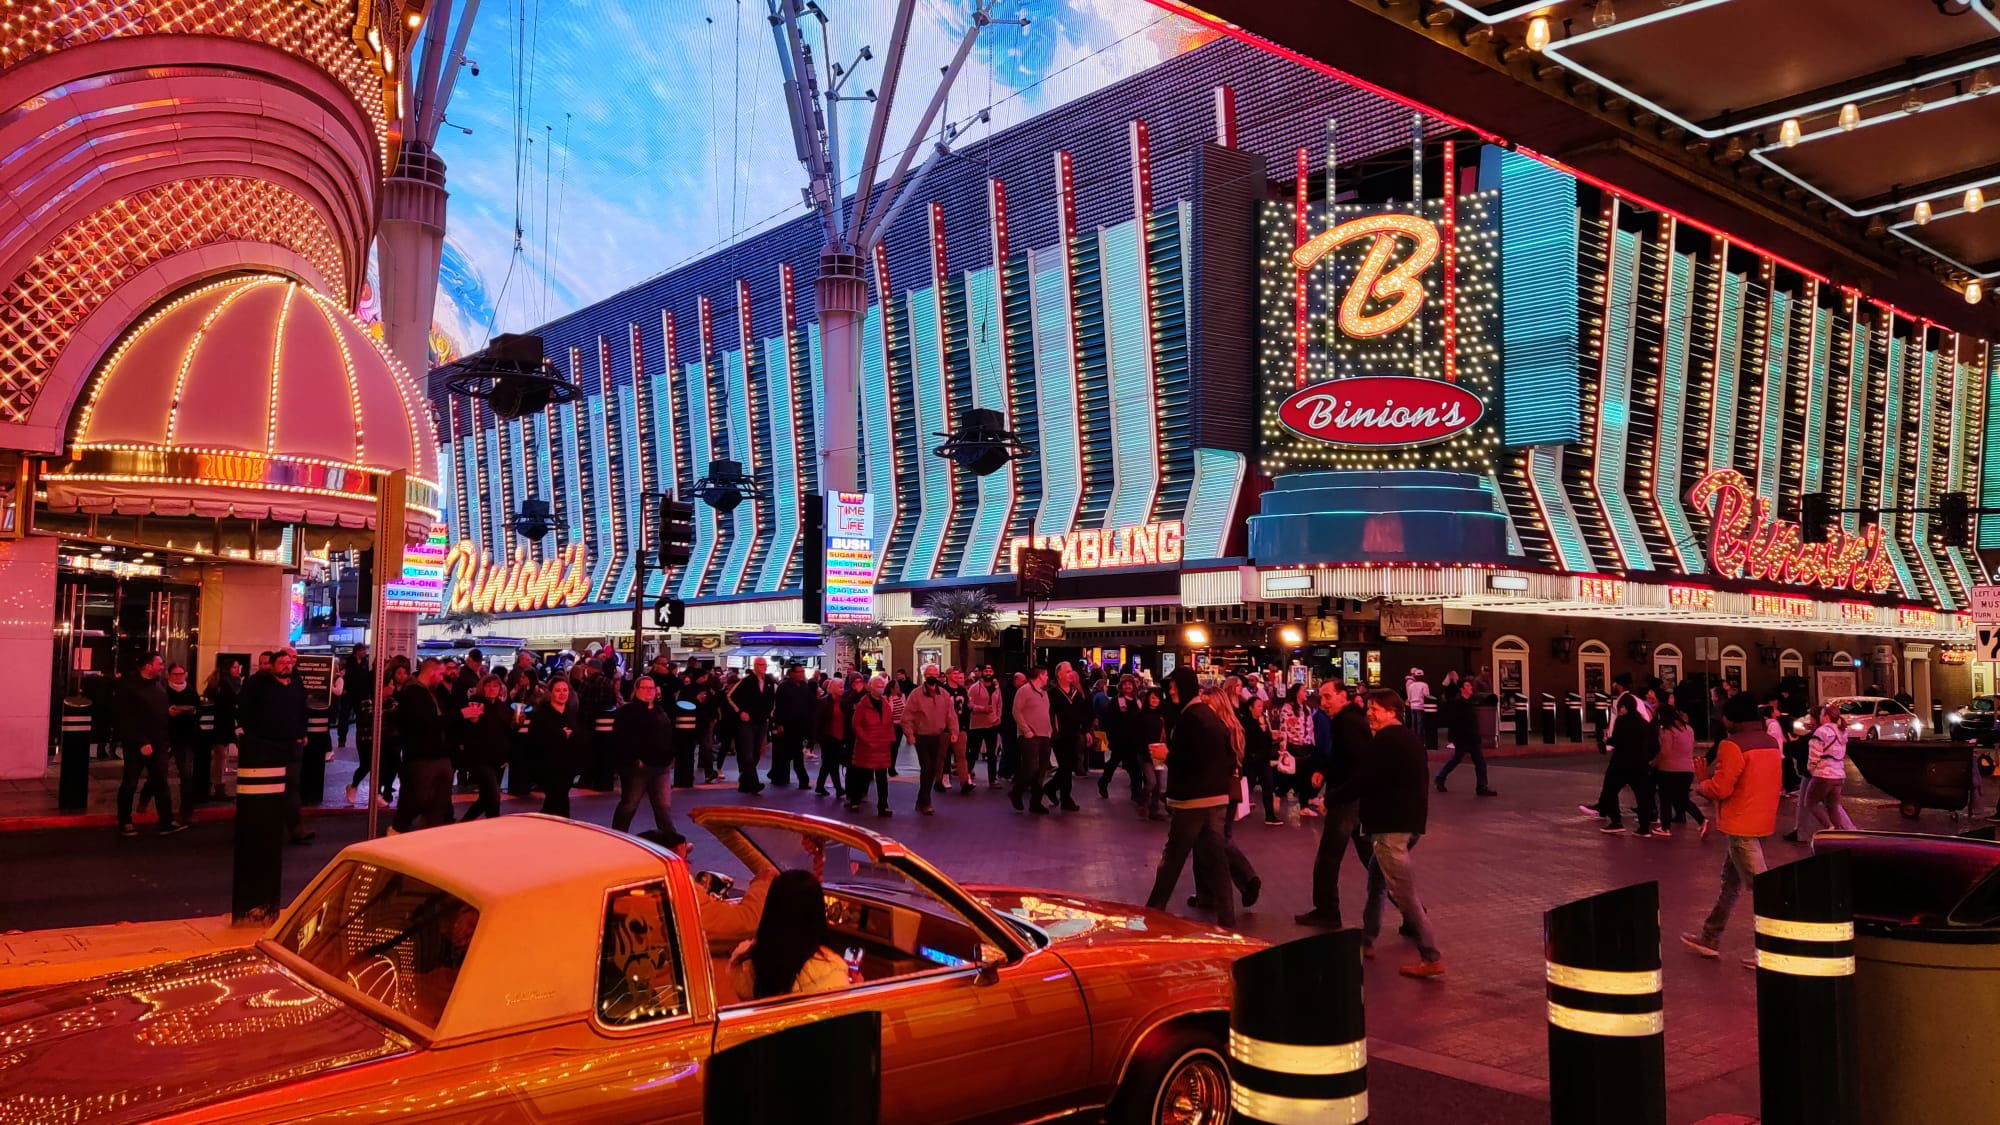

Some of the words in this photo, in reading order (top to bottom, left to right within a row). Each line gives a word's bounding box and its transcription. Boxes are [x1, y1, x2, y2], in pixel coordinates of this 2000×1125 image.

[1292, 214, 1441, 339] B
[1295, 394, 1467, 429] Binion's
[831, 538, 870, 550] BUSH
[1010, 520, 1183, 574] GMBLING
[415, 569, 438, 577] TEAM
[400, 590, 440, 598] SKRIBBLE
[1752, 596, 1813, 617] ROULETTE
[1841, 602, 1875, 623] SLOTS
